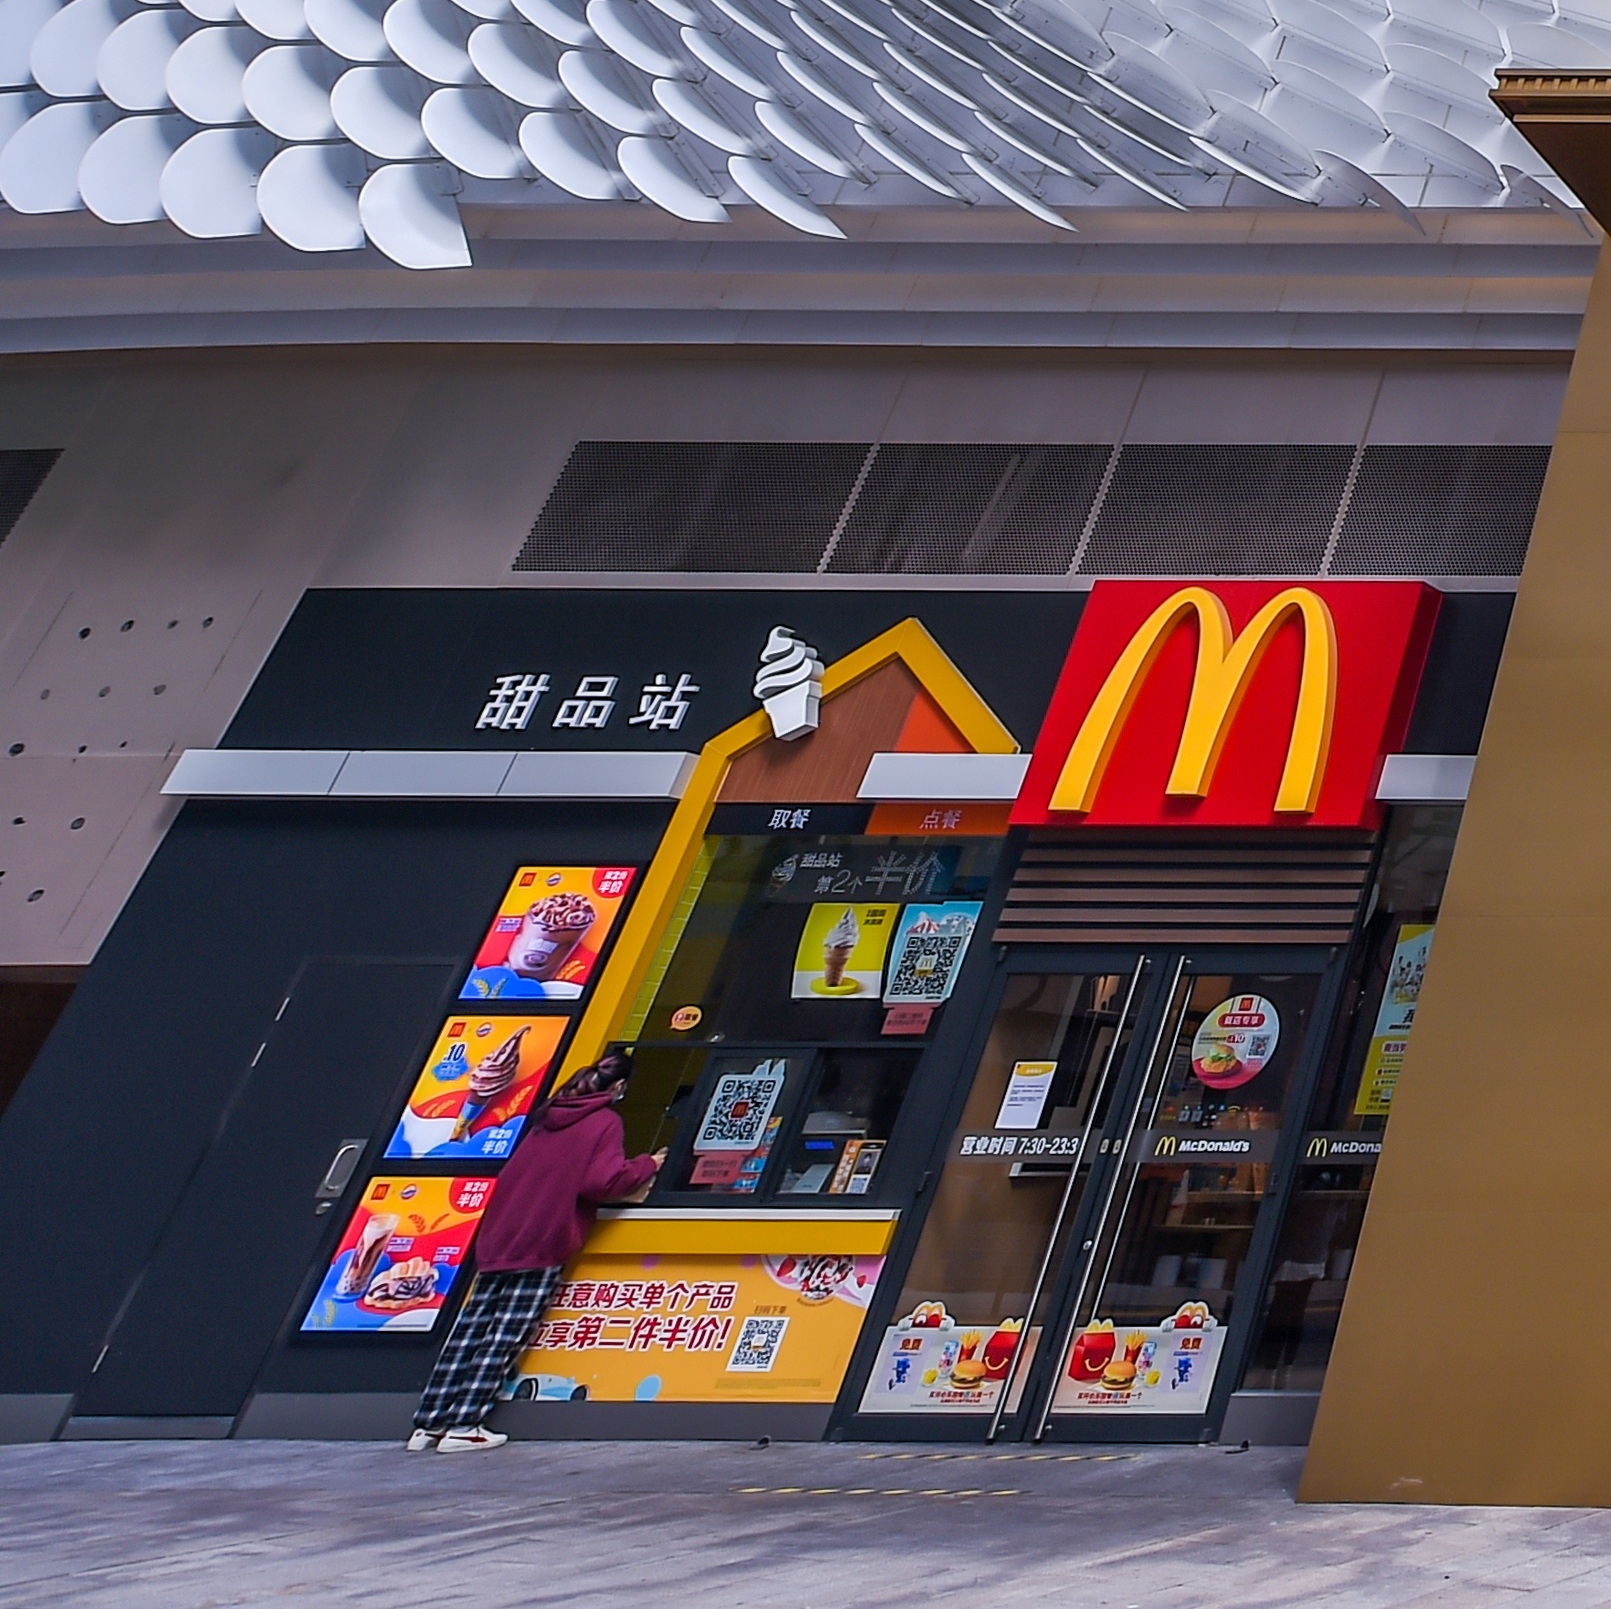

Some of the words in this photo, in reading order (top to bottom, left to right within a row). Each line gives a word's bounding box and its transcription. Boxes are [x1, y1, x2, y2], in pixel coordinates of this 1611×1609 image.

[476, 673, 700, 730] 甜品站
[768, 808, 812, 830] 取餐
[919, 809, 963, 830] 点餐
[1178, 1139, 1250, 1153] McDonald's
